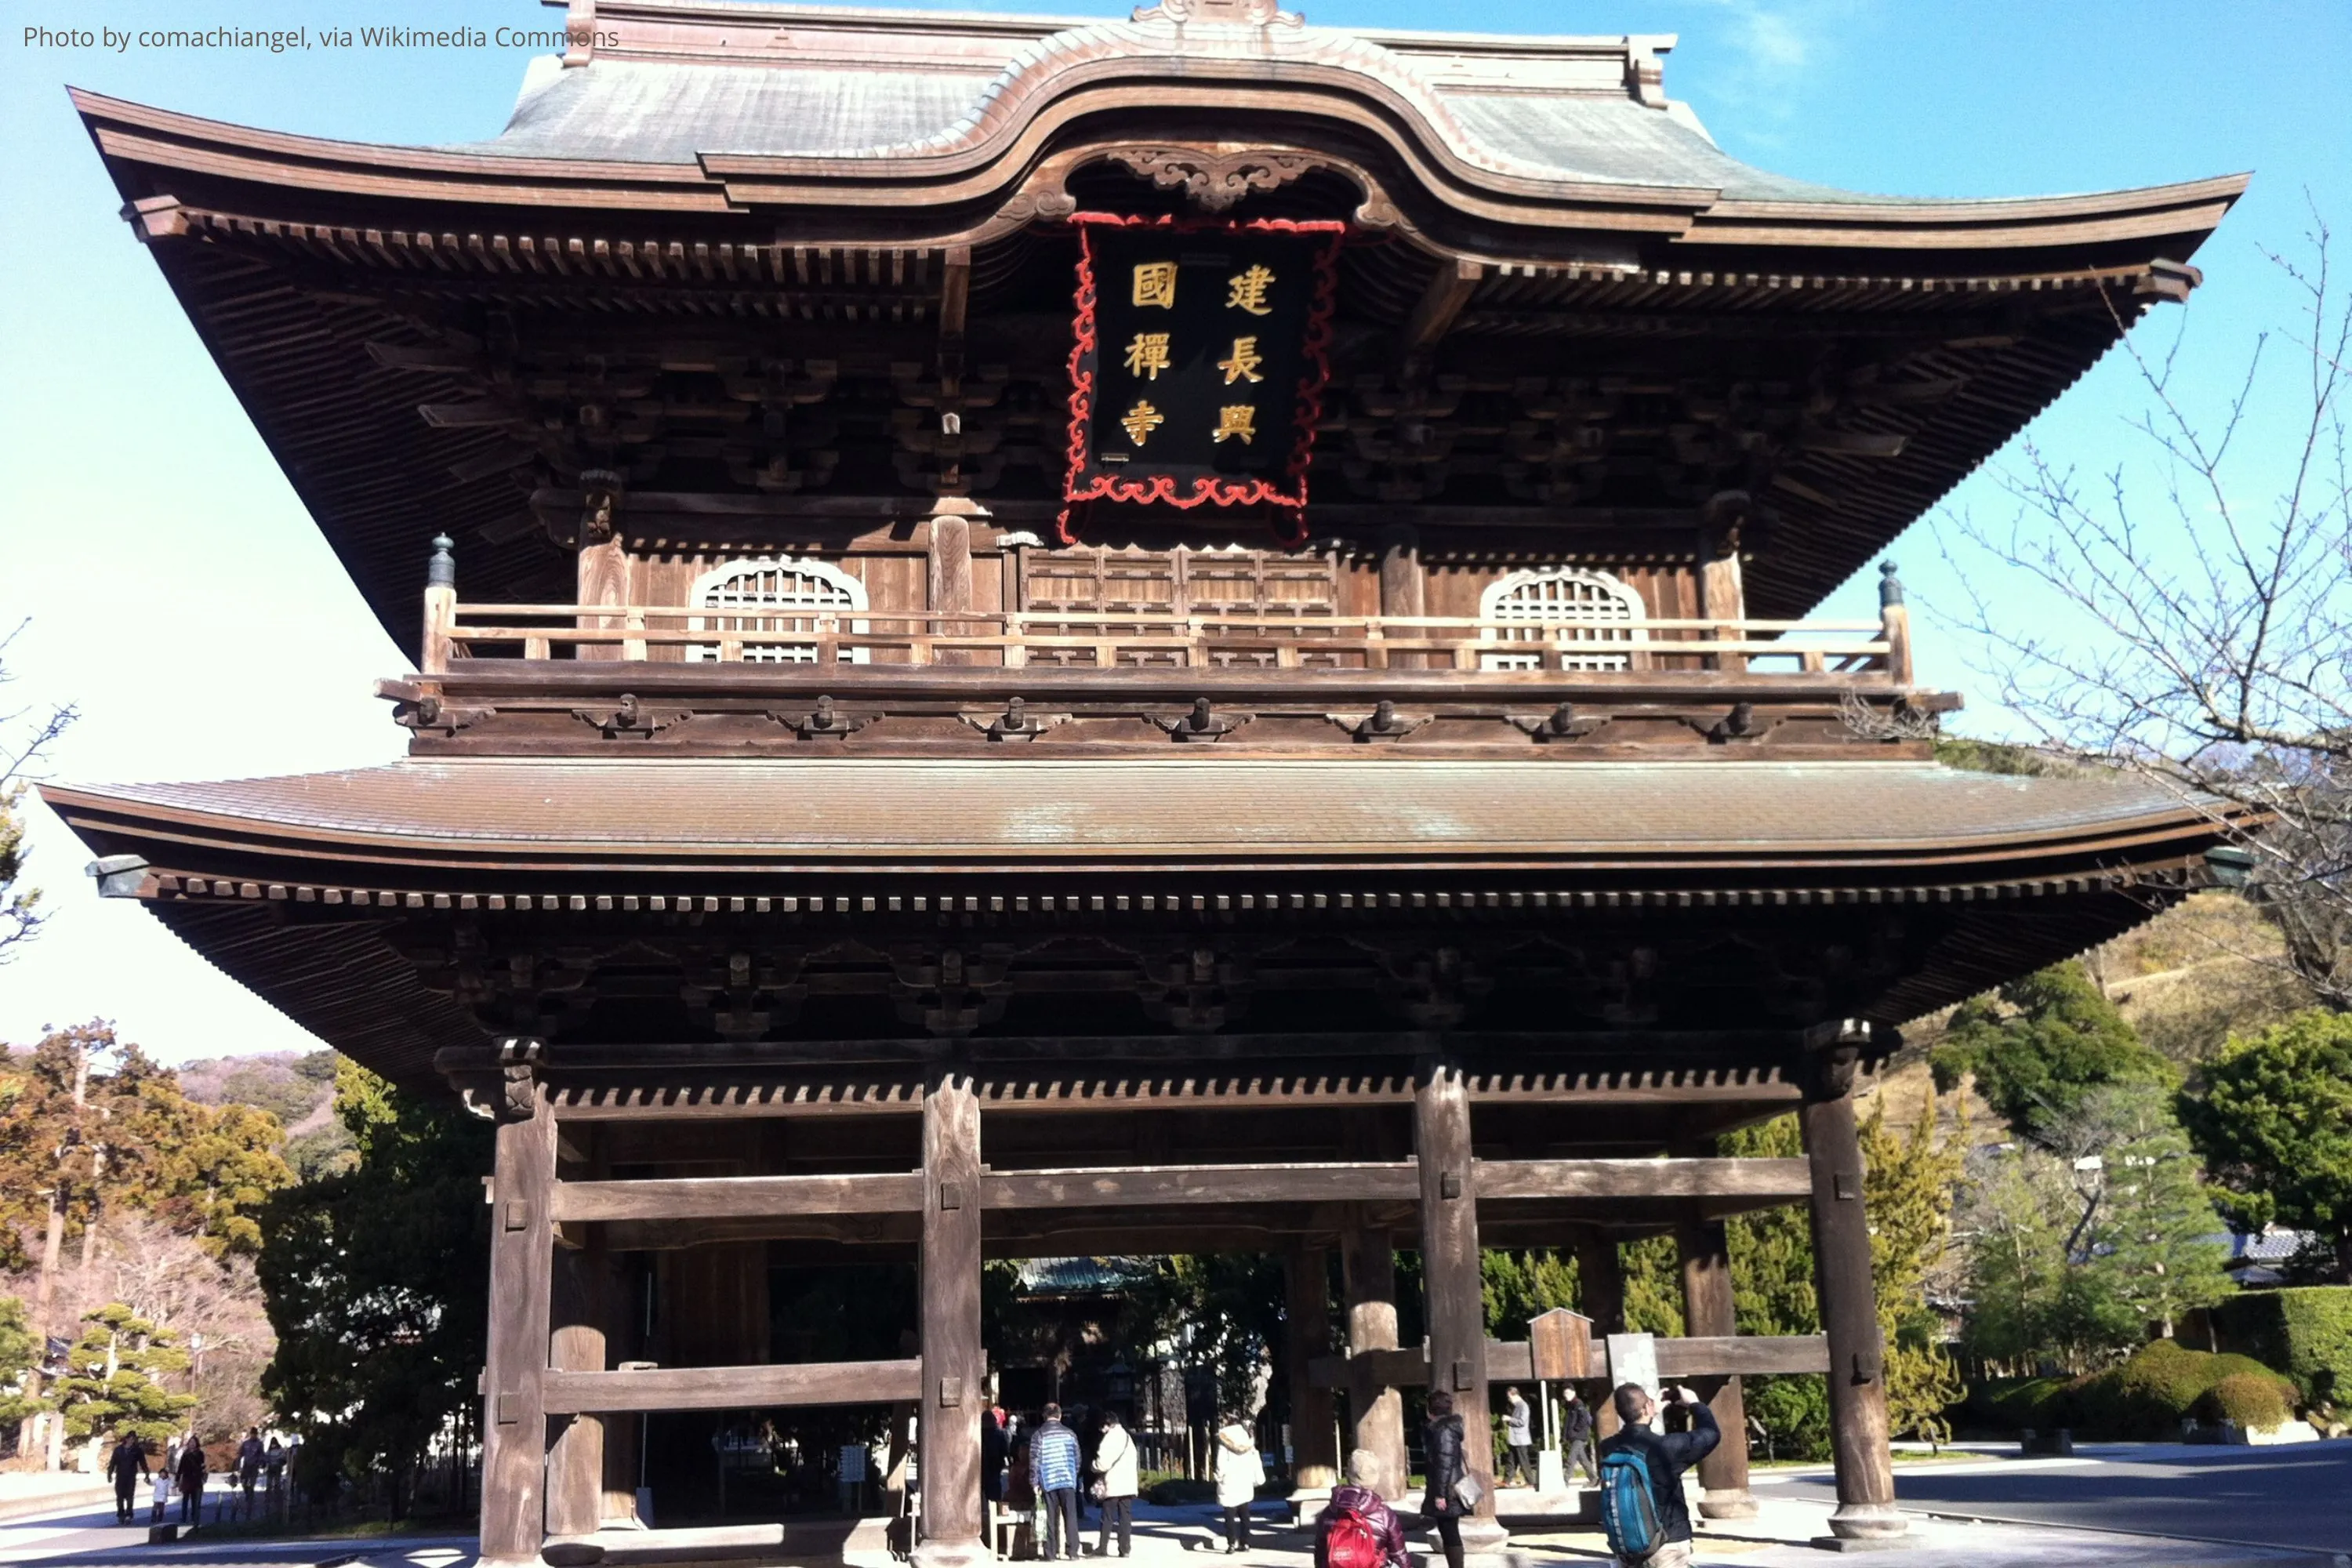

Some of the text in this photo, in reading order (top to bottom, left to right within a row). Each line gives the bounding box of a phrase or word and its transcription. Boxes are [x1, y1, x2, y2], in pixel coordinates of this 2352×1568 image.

[1122, 261, 1178, 446] 國禪寺
[1213, 264, 1276, 445] 建長興
